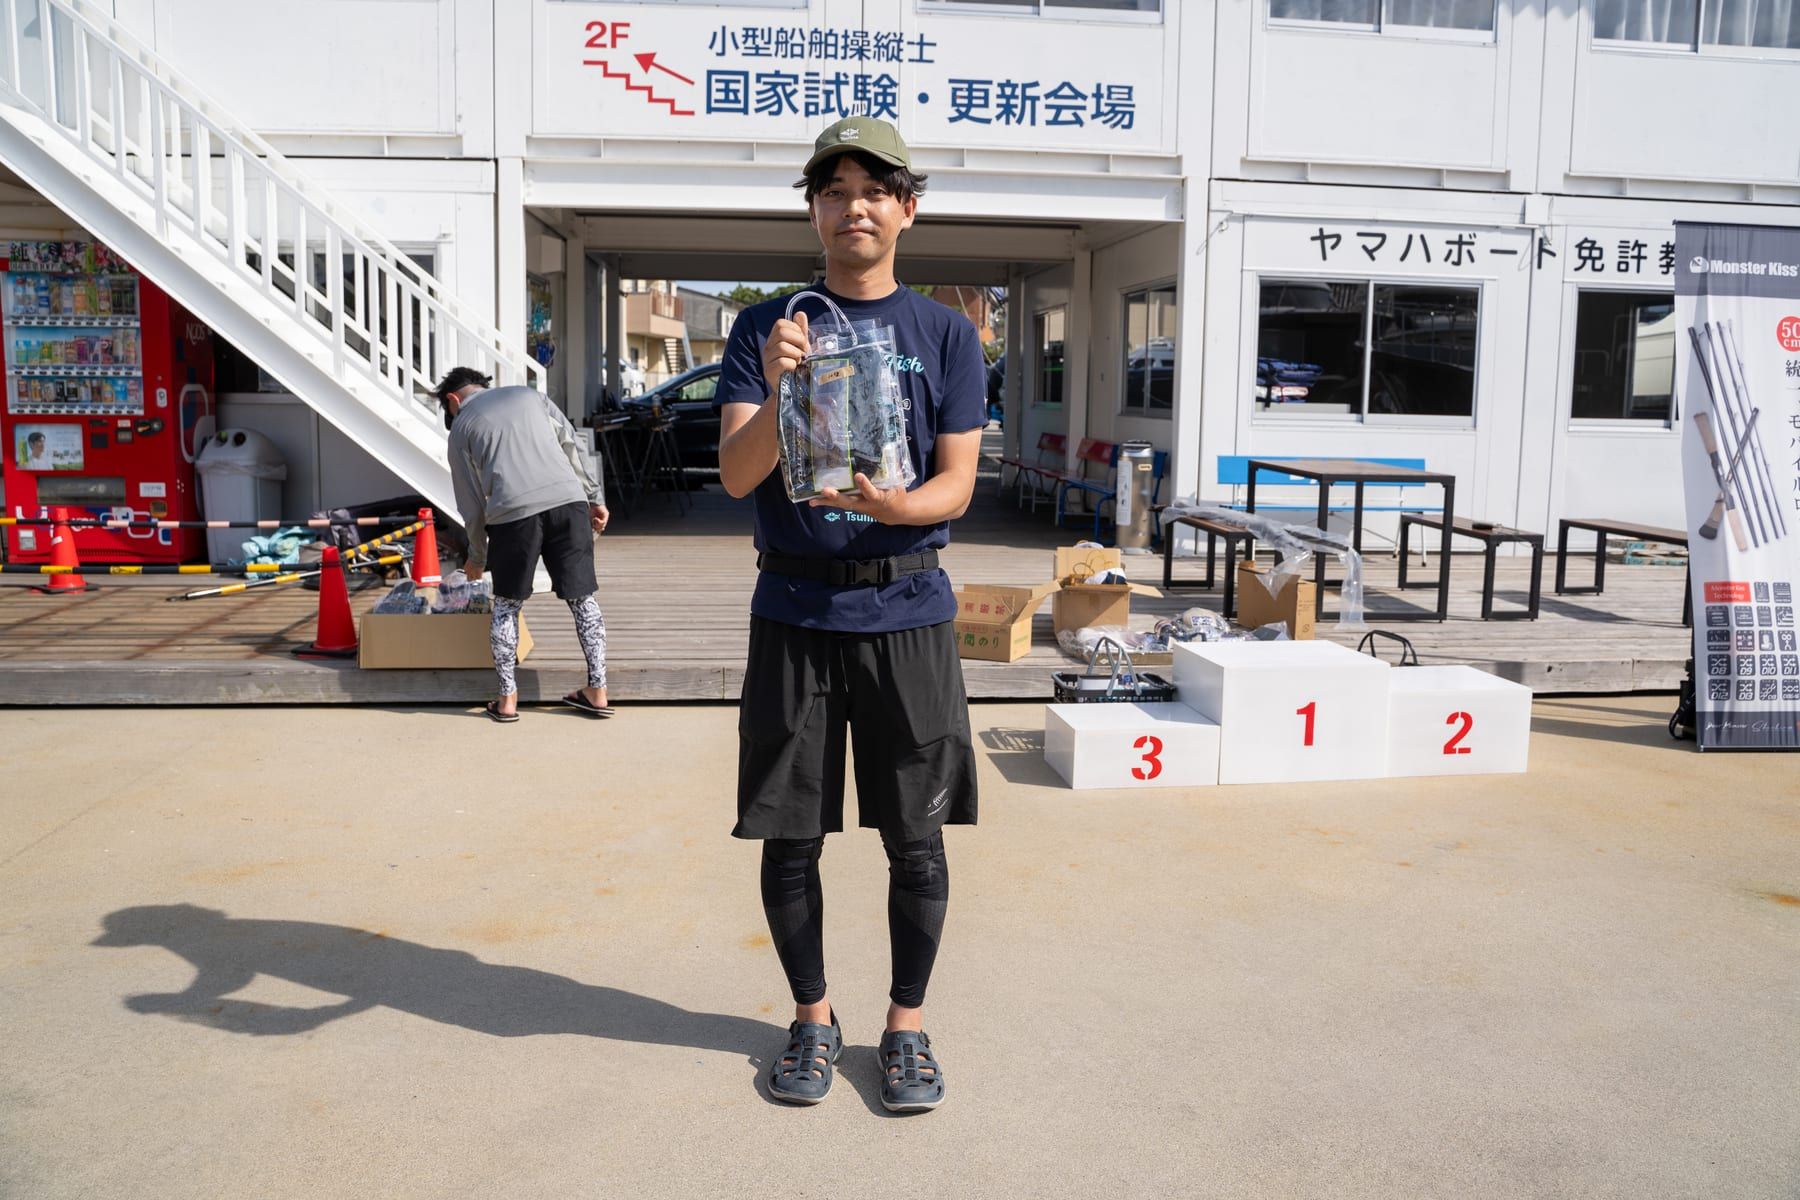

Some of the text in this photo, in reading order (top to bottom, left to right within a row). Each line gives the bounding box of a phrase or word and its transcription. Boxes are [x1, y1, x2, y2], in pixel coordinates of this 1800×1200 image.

[584, 20, 631, 49] 2F
[708, 25, 937, 64] 小型船舶操縦士
[1710, 260, 1798, 277] Monster Kiss
[1296, 702, 1317, 747] 1
[1443, 711, 1473, 755] 2
[1131, 735, 1164, 780] 3
